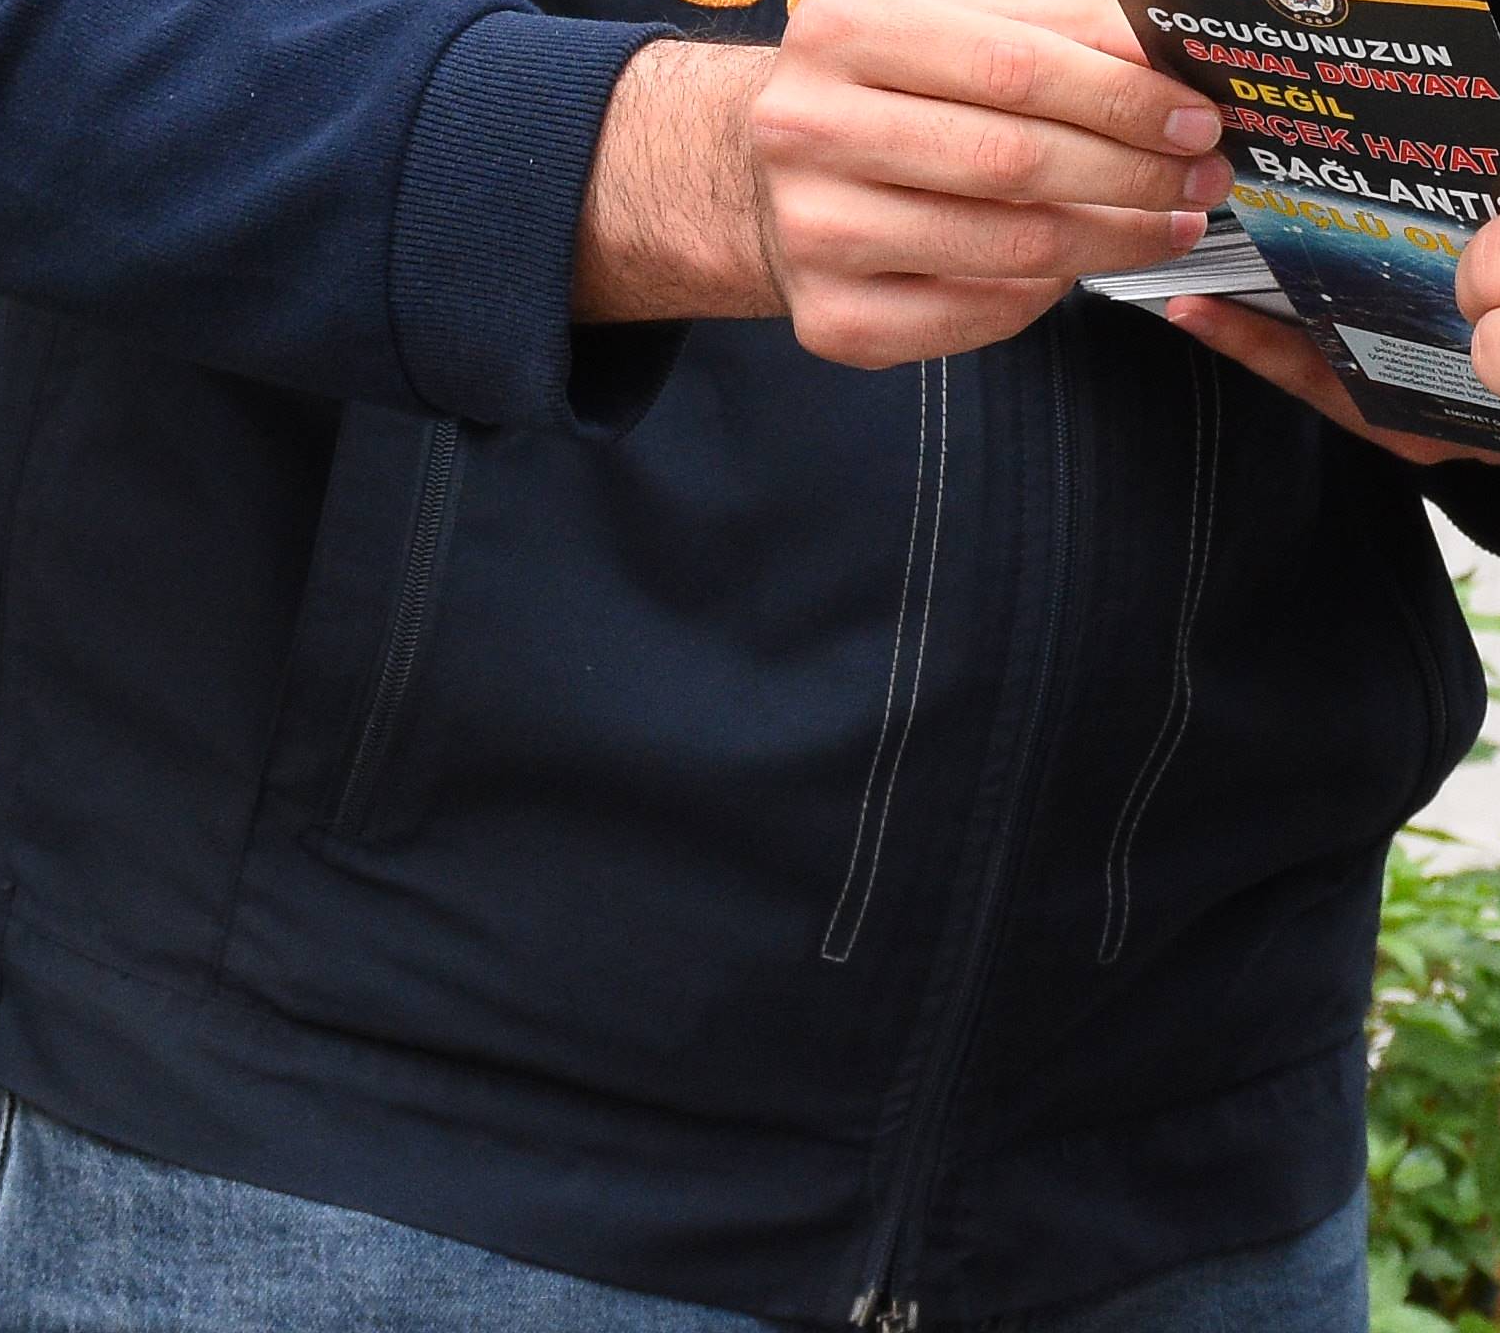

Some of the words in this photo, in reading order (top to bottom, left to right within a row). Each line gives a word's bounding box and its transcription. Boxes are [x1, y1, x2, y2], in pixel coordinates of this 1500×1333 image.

[1147, 7, 1453, 67] ÇOCUĞUNUZUN
[1182, 39, 1310, 80] SANAL
[1314, 62, 1500, 101] DÜNYAYA
[1228, 78, 1355, 121] DEĞİL
[1218, 103, 1360, 155] ERÇEK
[1232, 184, 1391, 241] GÜÇLÜ
[1403, 226, 1466, 259] OL
